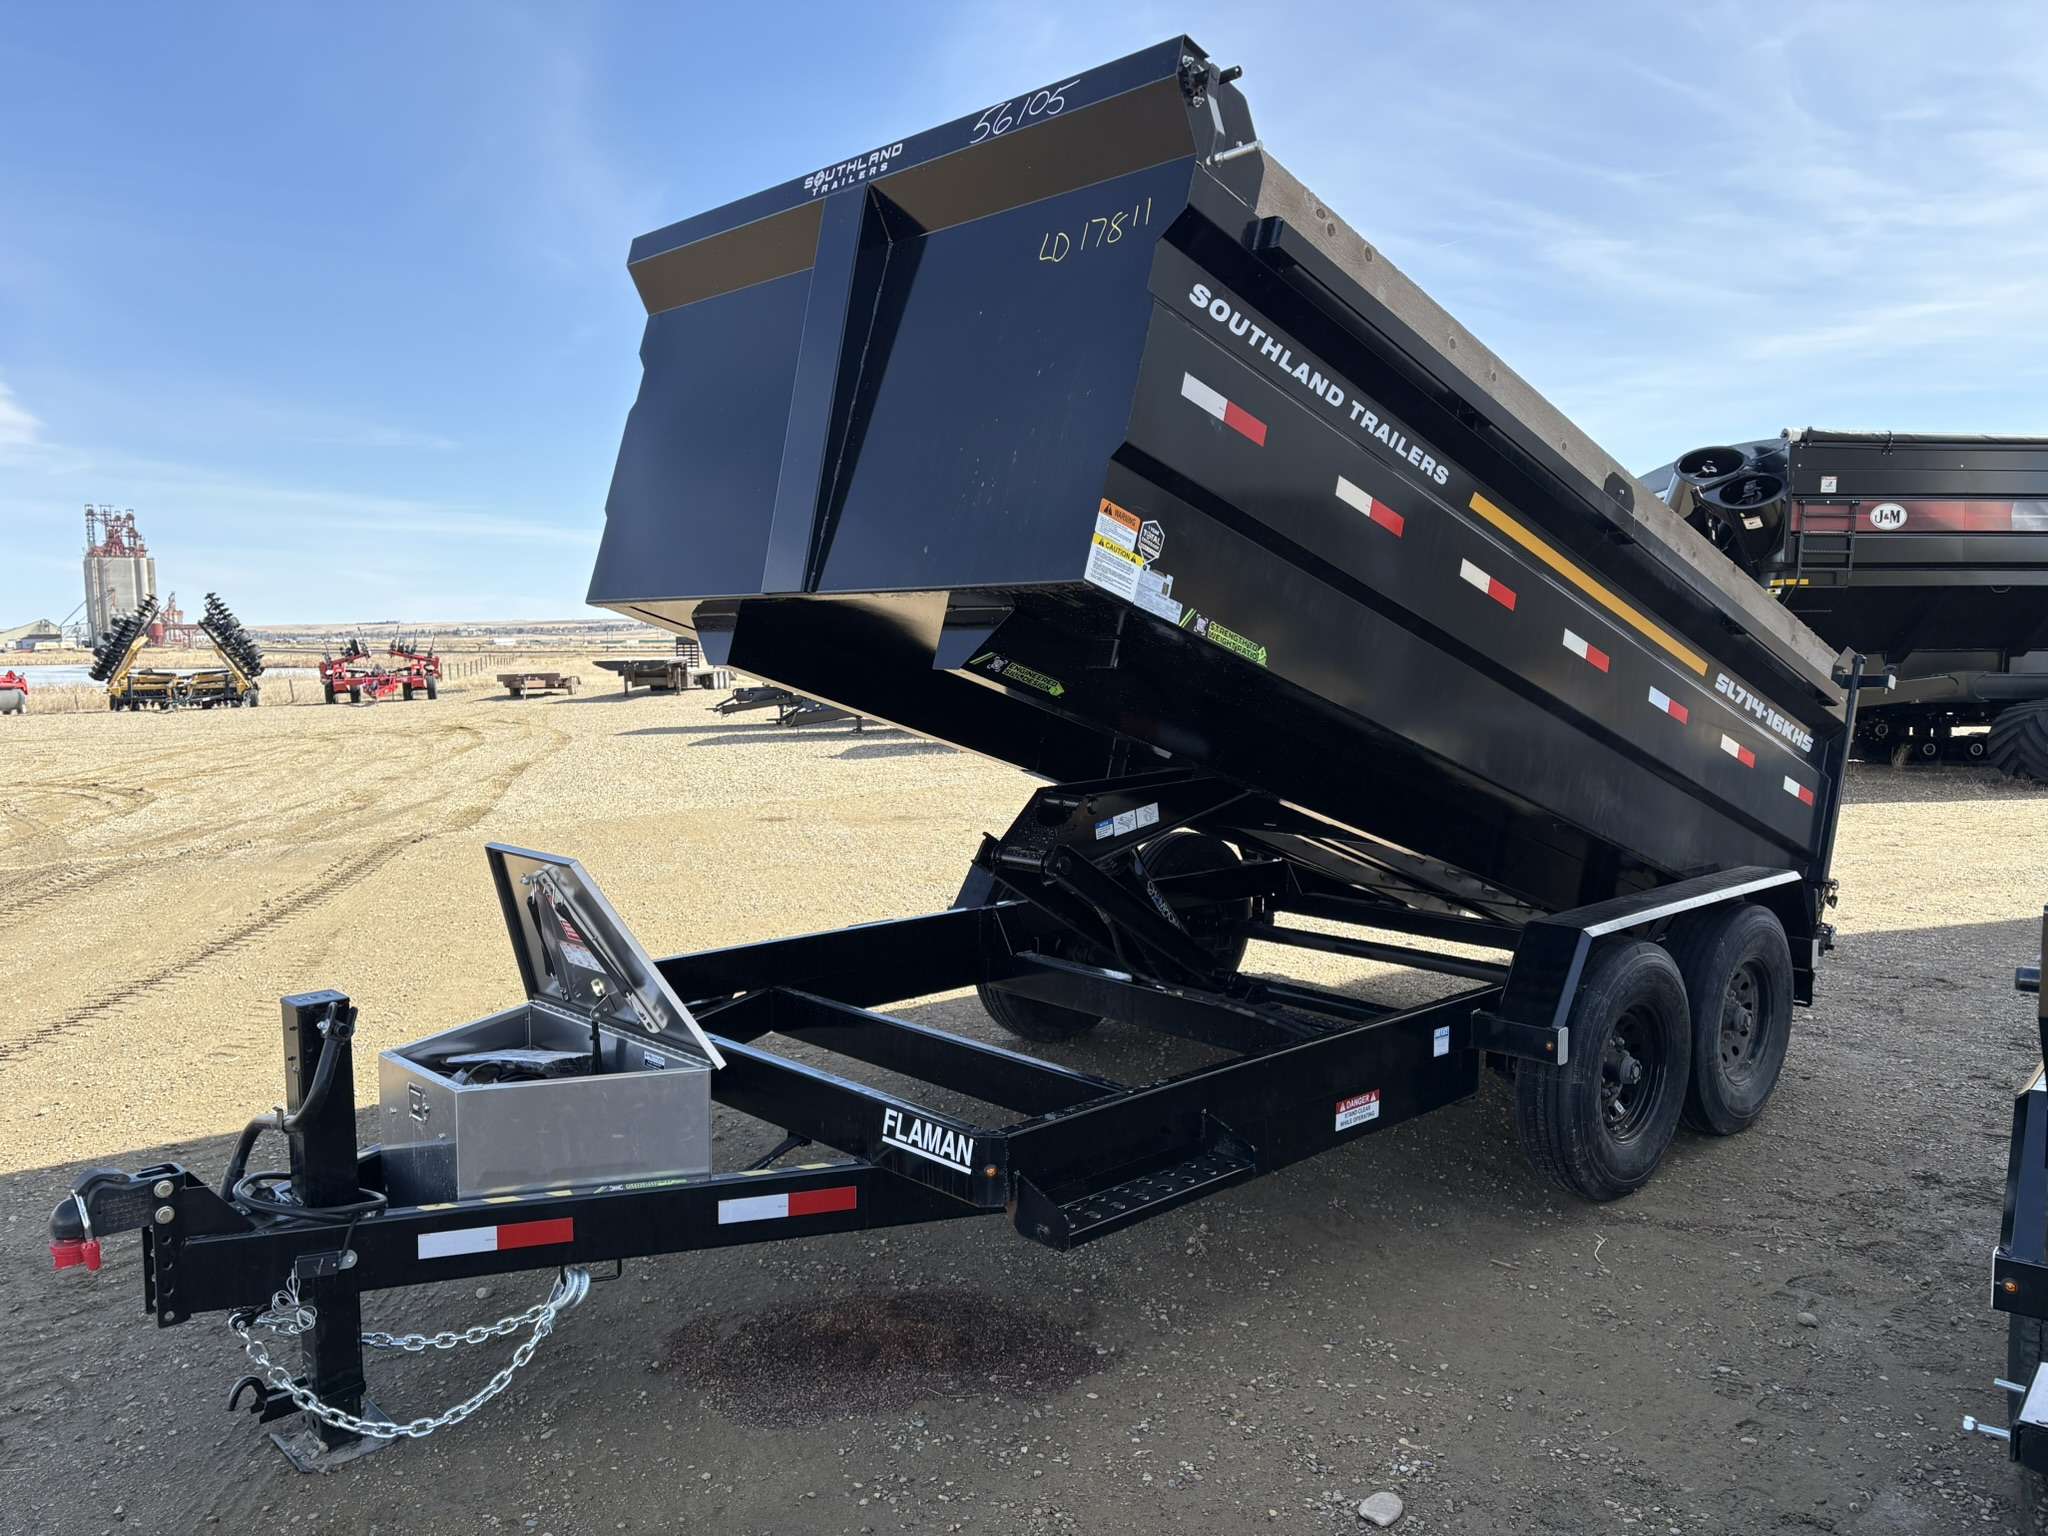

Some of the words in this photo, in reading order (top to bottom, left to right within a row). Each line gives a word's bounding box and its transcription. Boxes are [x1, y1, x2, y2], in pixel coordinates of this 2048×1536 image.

[969, 79, 1081, 144] 56105
[804, 143, 903, 189] SOUTHLAND
[812, 162, 889, 196] TRAILERS
[1189, 283, 1345, 407] SOUTHLAND
[1350, 400, 1449, 485] TRAILERS
[1874, 509, 1901, 523] J&M
[1105, 542, 1131, 560] CAUTION
[1346, 1094, 1370, 1109] DANGER
[882, 1107, 975, 1167] FLAMAN
